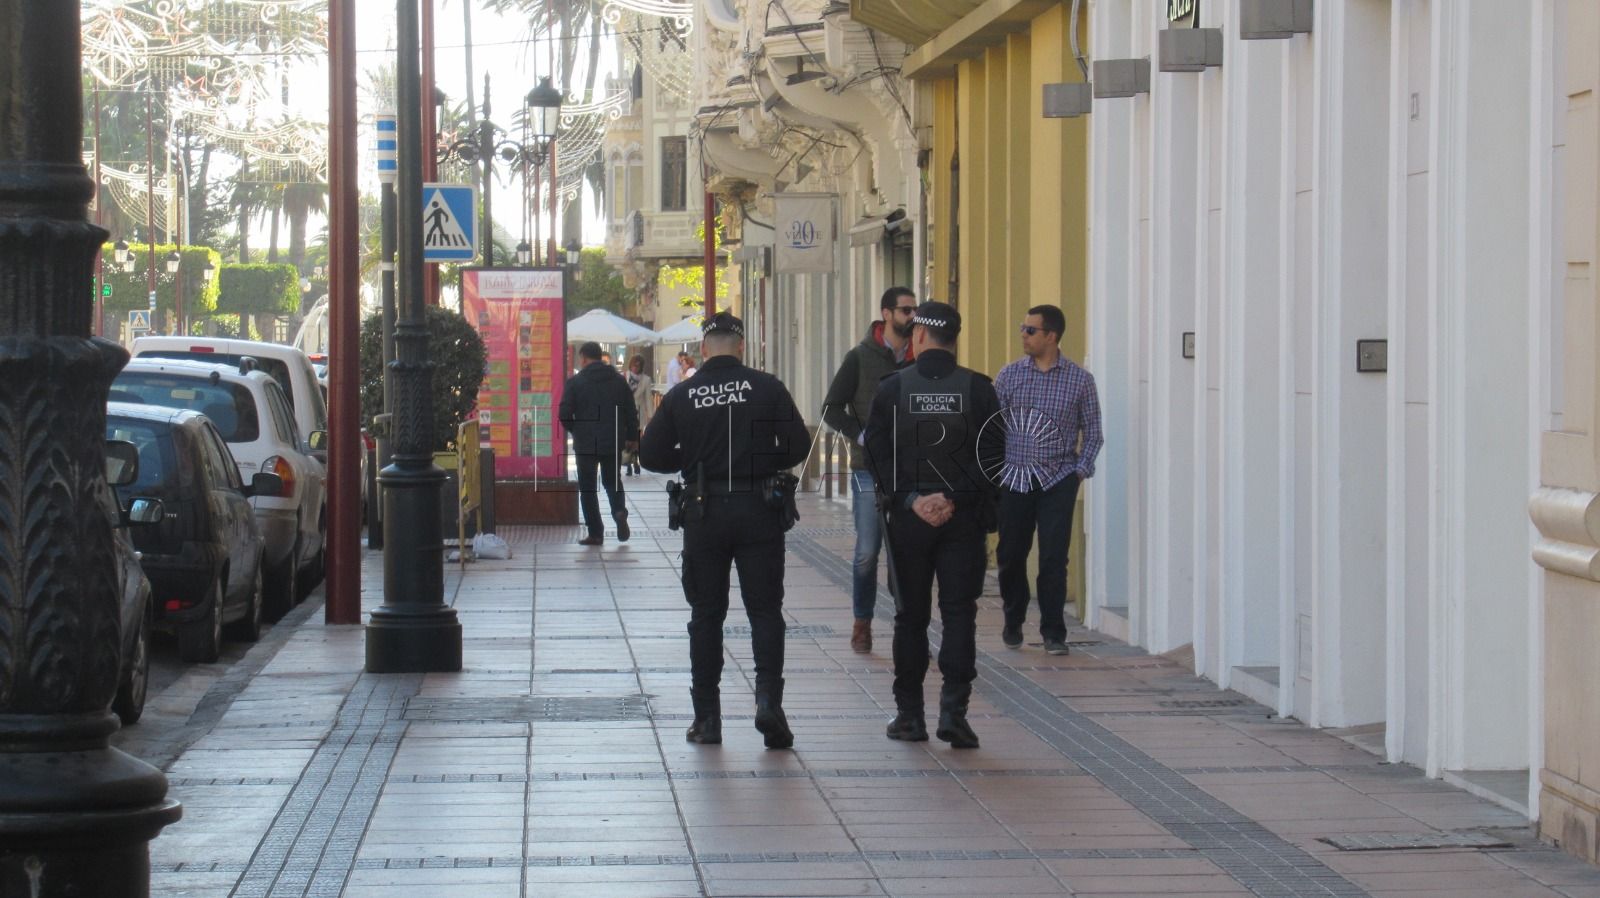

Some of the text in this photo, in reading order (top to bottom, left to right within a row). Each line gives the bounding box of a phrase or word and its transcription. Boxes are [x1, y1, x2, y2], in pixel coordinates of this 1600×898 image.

[792, 220, 814, 245] 20
[688, 380, 752, 399] POLICIA
[694, 392, 747, 409] LOCAL
[916, 395, 956, 404] POLICIA
[921, 404, 952, 412] LOCAL
